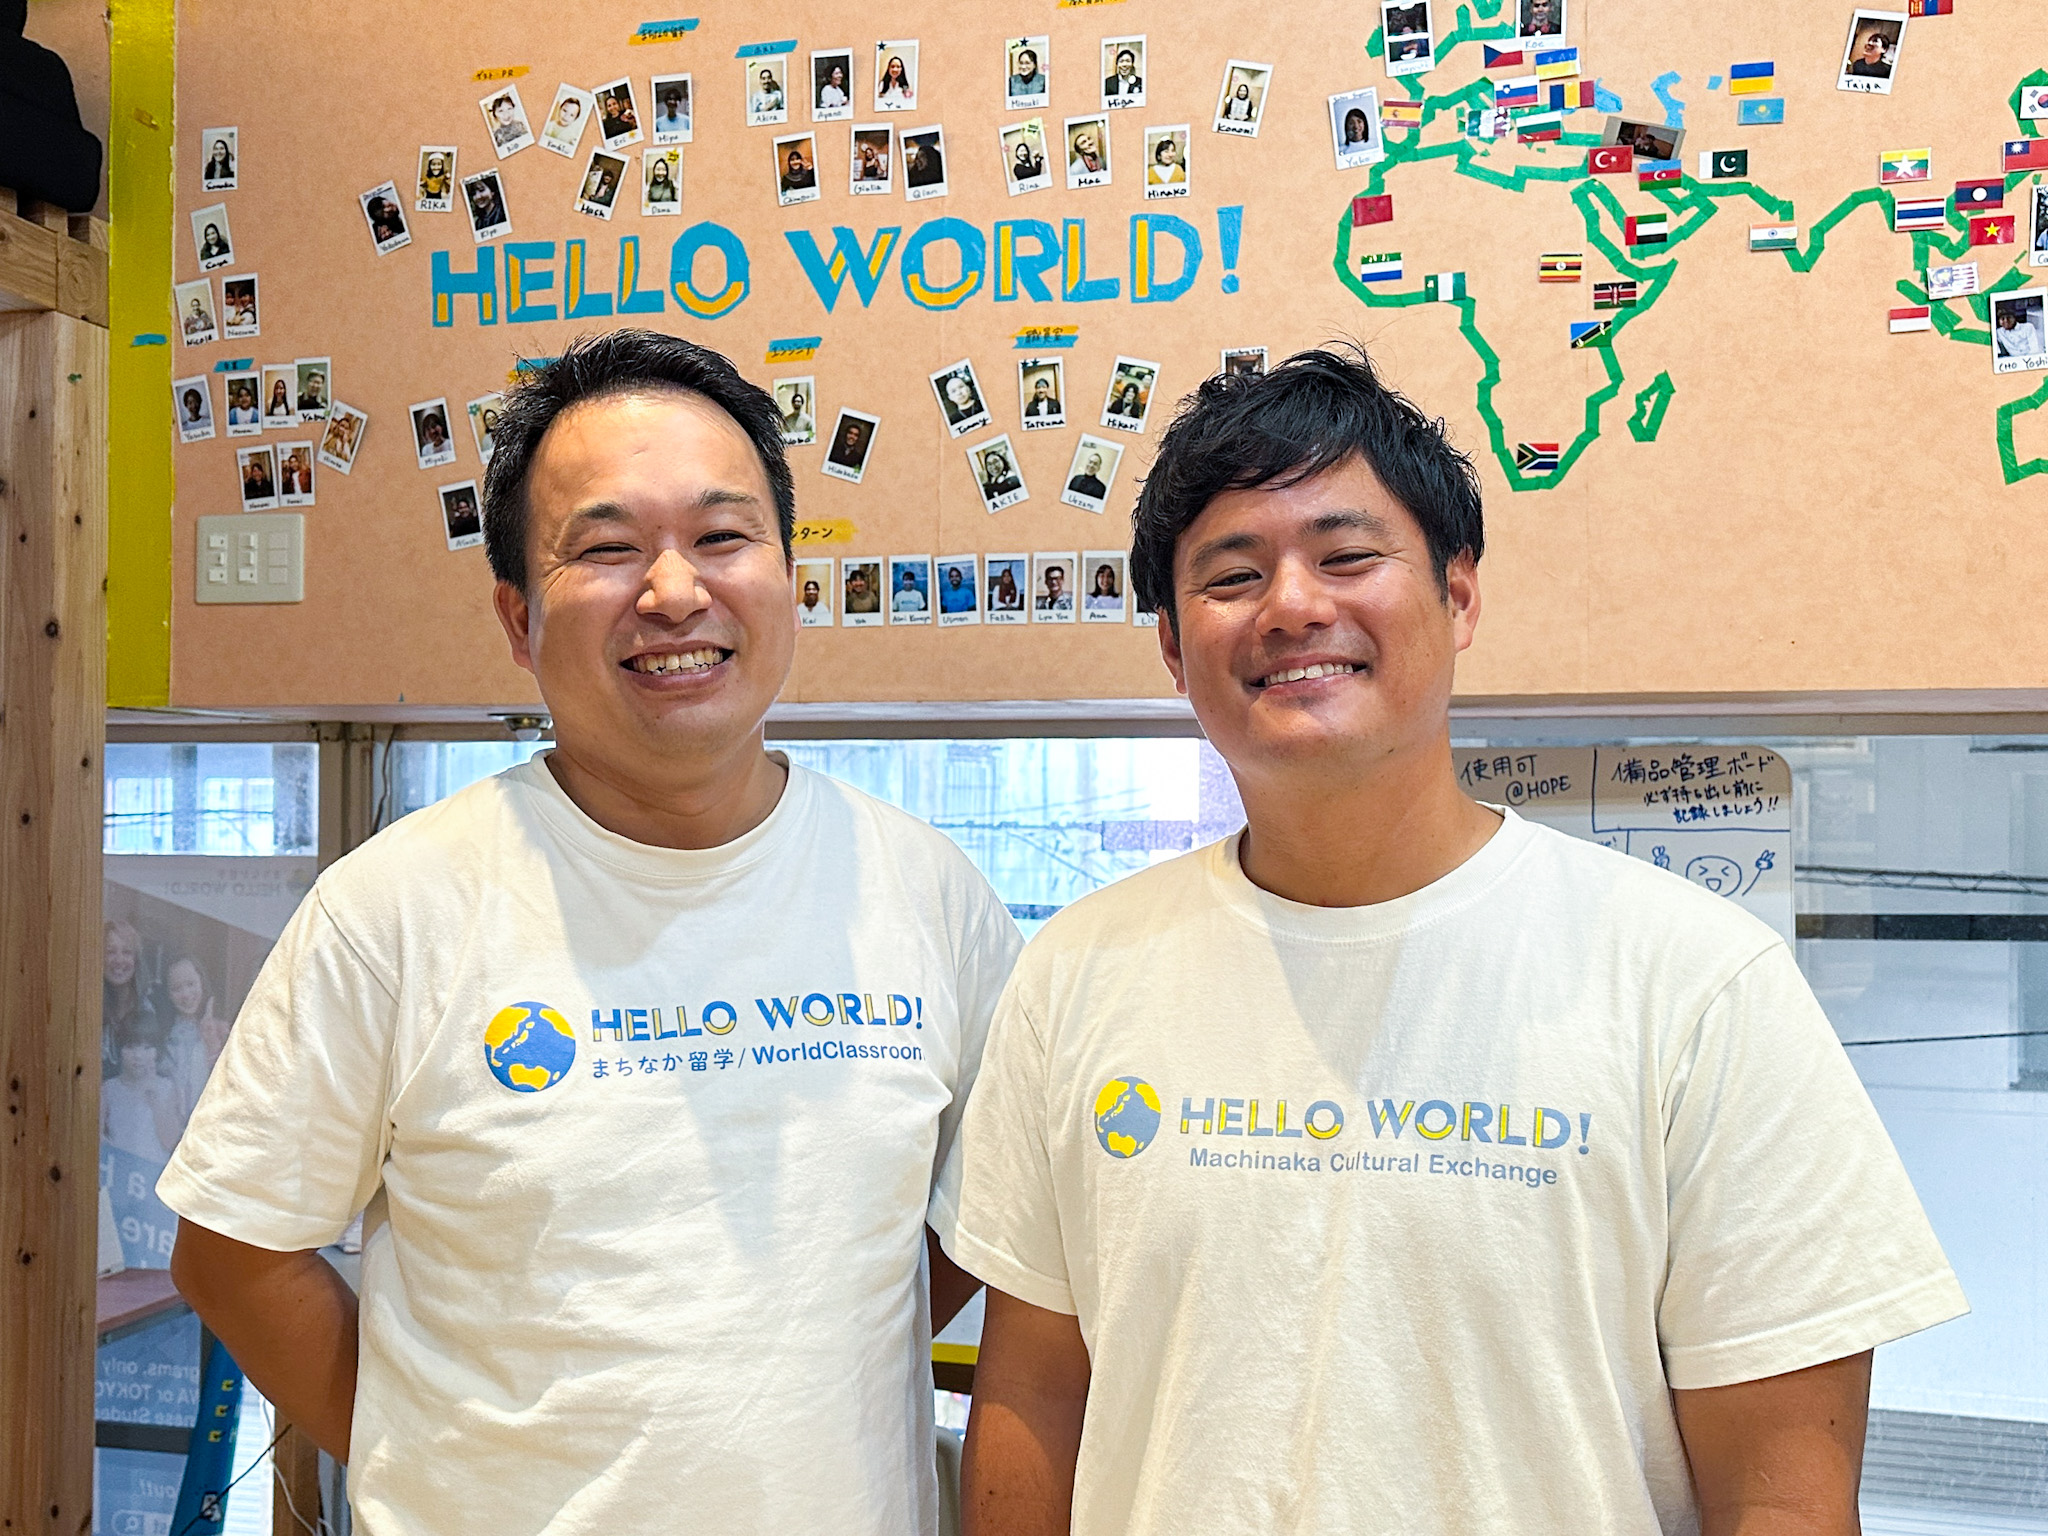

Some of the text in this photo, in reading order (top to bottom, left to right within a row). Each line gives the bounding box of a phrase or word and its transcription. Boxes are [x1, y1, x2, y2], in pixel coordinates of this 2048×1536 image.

[1845, 80, 1882, 92] Taiga
[1217, 123, 1254, 136] Konomi
[420, 199, 446, 210] RIKA
[432, 205, 1244, 327] HELLO WORLD!
[1460, 754, 1538, 787] 使用可
[1611, 752, 1775, 784] 備品管理ボード
[1505, 775, 1571, 806] @HOPE
[1643, 779, 1764, 807] 必ず持ち出し前に
[591, 992, 924, 1042] HELLO WORLD!
[1179, 1096, 1592, 1155] HELLO WORLD!
[1189, 1147, 1558, 1188] Machinaka Cultural Exchange
